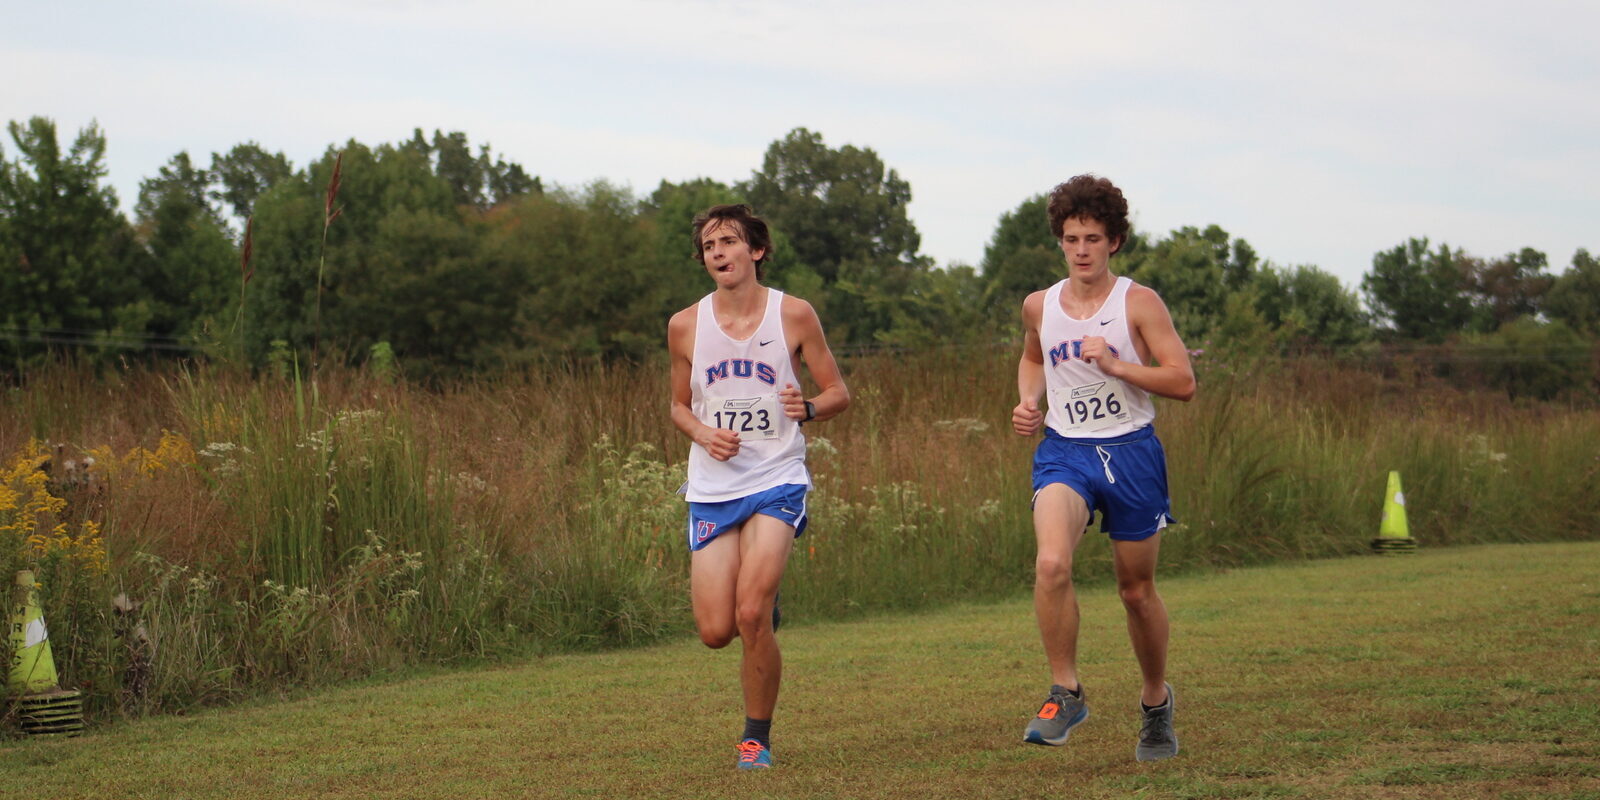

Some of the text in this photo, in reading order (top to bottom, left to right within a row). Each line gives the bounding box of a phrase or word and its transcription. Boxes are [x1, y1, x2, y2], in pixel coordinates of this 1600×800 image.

[705, 358, 776, 388] MUS
[714, 409, 770, 432] 1723
[1064, 392, 1121, 424] 1926
[697, 520, 716, 543] U
